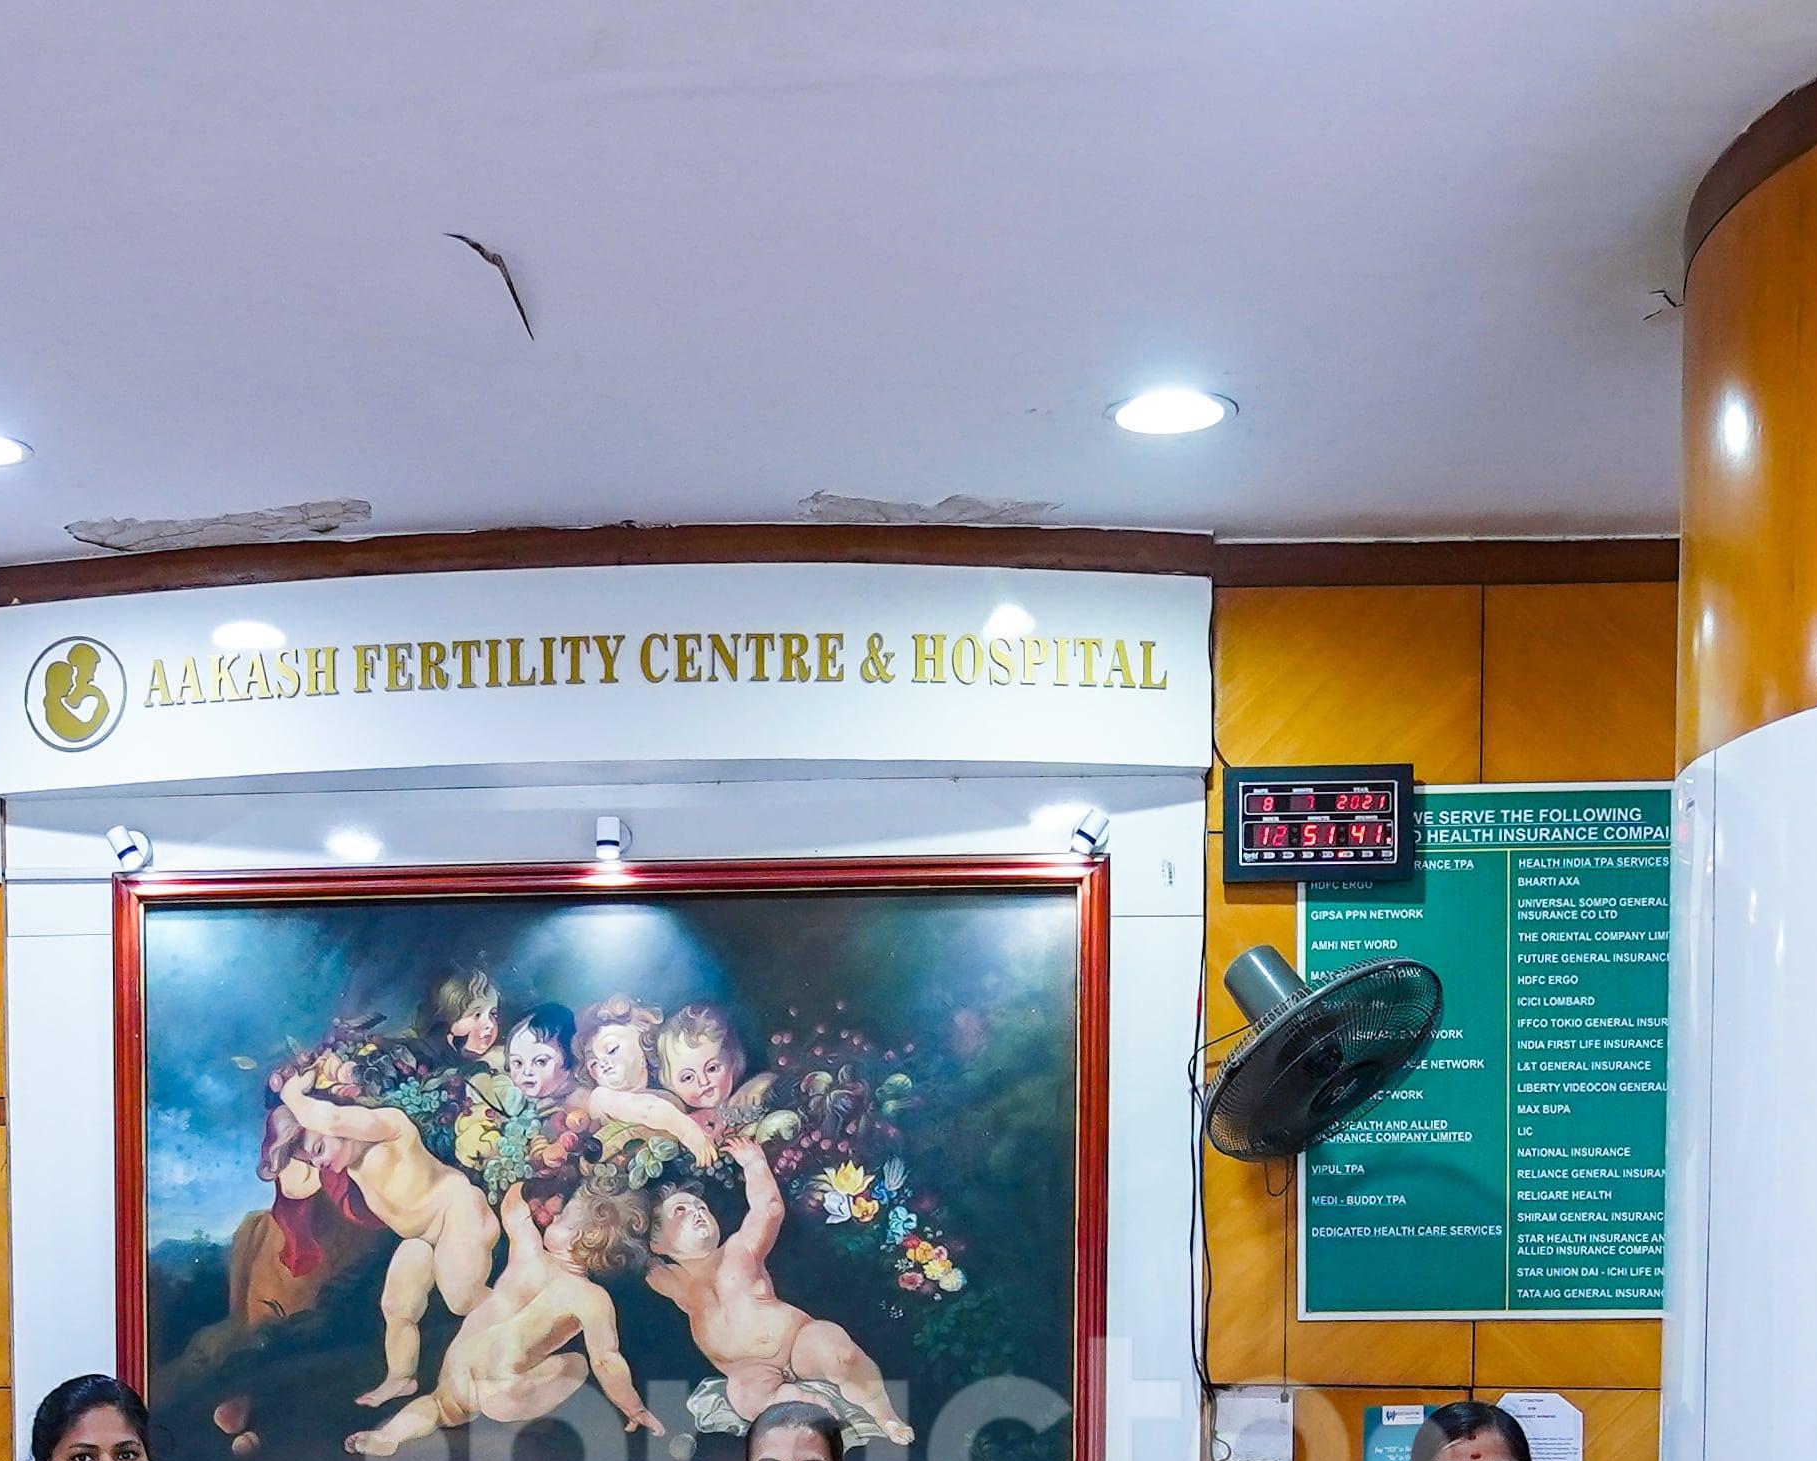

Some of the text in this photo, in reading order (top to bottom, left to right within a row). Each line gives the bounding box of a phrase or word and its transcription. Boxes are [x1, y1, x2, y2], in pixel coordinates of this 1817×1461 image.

[143, 632, 1167, 707] AAKASH FERTILITY CENTRE & HOSPITAL
[1262, 796, 1274, 811] 8
[1336, 795, 1386, 810] 2021
[1439, 810, 1495, 824] SERVE
[1501, 809, 1533, 823] THE
[1539, 808, 1642, 822] FOLLOWING
[1262, 825, 1382, 846] 12 51 41
[1427, 829, 1493, 843] HEALTH
[1499, 827, 1598, 841] INSURANCE
[1454, 860, 1474, 869] TPA
[1519, 856, 1669, 868] HEALTH INDIA TPA SERVICES
[1518, 877, 1580, 887] BHARTI AXA
[1518, 897, 1668, 908] UNIVERSAL SOMPO GENERAL
[1311, 909, 1423, 920] GIPSA PPN NETWORK
[1518, 910, 1618, 920] INSURANCE CO LTD
[1518, 932, 1645, 942] THE ORIENTAL COMPANY
[1311, 940, 1398, 950] AMHI NET WORD
[1518, 953, 1610, 963] FUTURE GENERAL
[1518, 975, 1578, 984] HDFC ERGO
[1518, 997, 1595, 1006] ICICI LOMBARD
[1518, 1019, 1548, 1028] IFFCO
[1551, 1019, 1582, 1027] TOKIO
[1585, 1018, 1634, 1027] GENERAL
[1518, 1039, 1663, 1049] INDIA FIRST LIFE INSURANCE
[1431, 1060, 1484, 1069] NETWORK
[1518, 1061, 1651, 1071] L&T GENERAL INSURANCE
[1518, 1083, 1561, 1092] LIBERTY
[1563, 1083, 1616, 1092] VIDEOCON
[1518, 1105, 1571, 1114] MAX BUPA
[1385, 1121, 1408, 1130] AND
[1410, 1120, 1447, 1129] ALLIED
[1518, 1127, 1533, 1136] LIC
[1376, 1132, 1472, 1142] COMPANY LIMITED
[1518, 1147, 1631, 1157] NATIONAL INSURANCE
[1312, 1164, 1365, 1174] VIPUL TPA
[1518, 1169, 1620, 1178] RELIANCE GENERAL
[1312, 1195, 1406, 1205] MEDI BUDDY TPA
[1518, 1191, 1612, 1200] RELIGARE HEALTH
[1517, 1213, 1557, 1222] SHIRAM
[1560, 1212, 1608, 1221] GENERAL
[1312, 1225, 1502, 1237] DEDICATED HEALTH CARE SERVICES
[1517, 1234, 1649, 1243] STAR HEALTH INSURANCE
[1517, 1246, 1615, 1255] ALLIED INSURANCE
[1517, 1267, 1651, 1277] STAR UNION DAI ICHI LIFE
[1517, 1289, 1612, 1298] TATA AIG GENERAL
